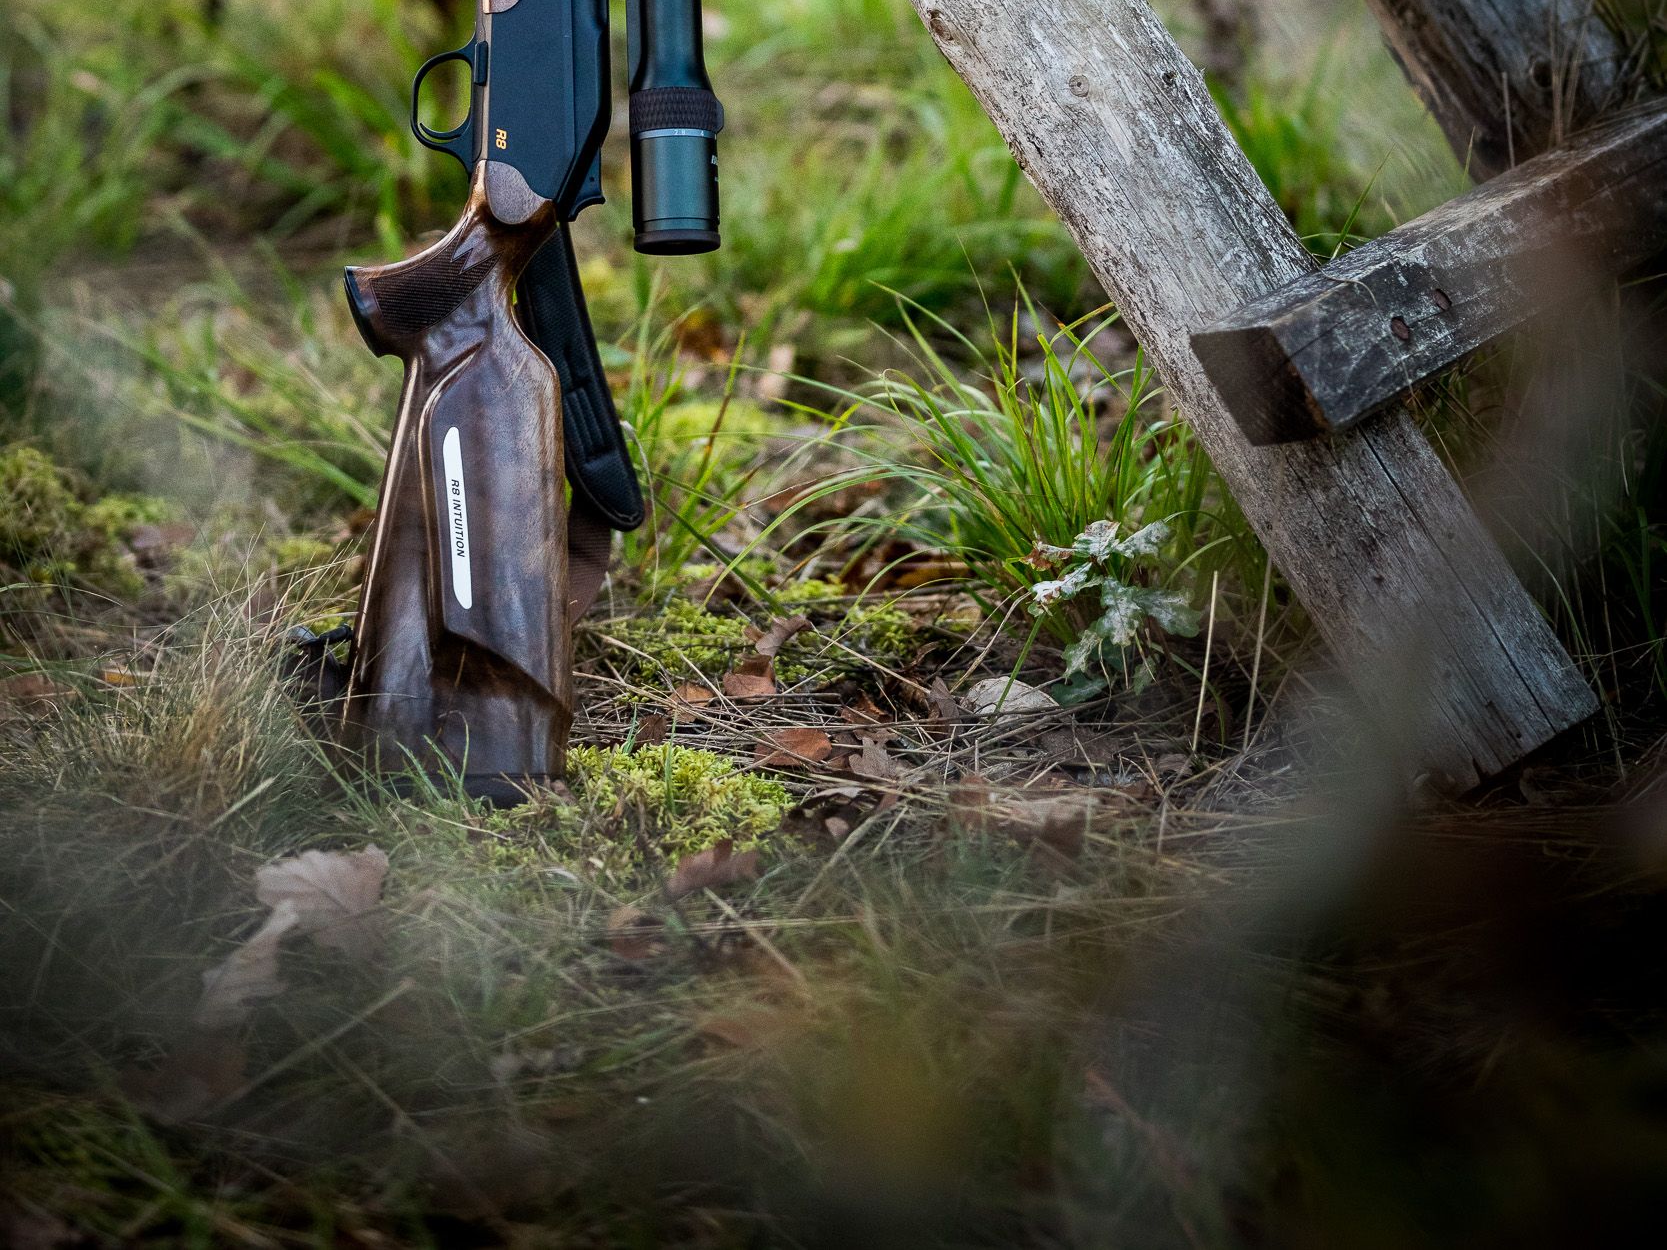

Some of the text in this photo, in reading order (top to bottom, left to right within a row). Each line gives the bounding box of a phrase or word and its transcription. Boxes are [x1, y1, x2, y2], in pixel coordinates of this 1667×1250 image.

[496, 128, 507, 150] R8
[451, 479, 466, 558] R8 INTUITION
